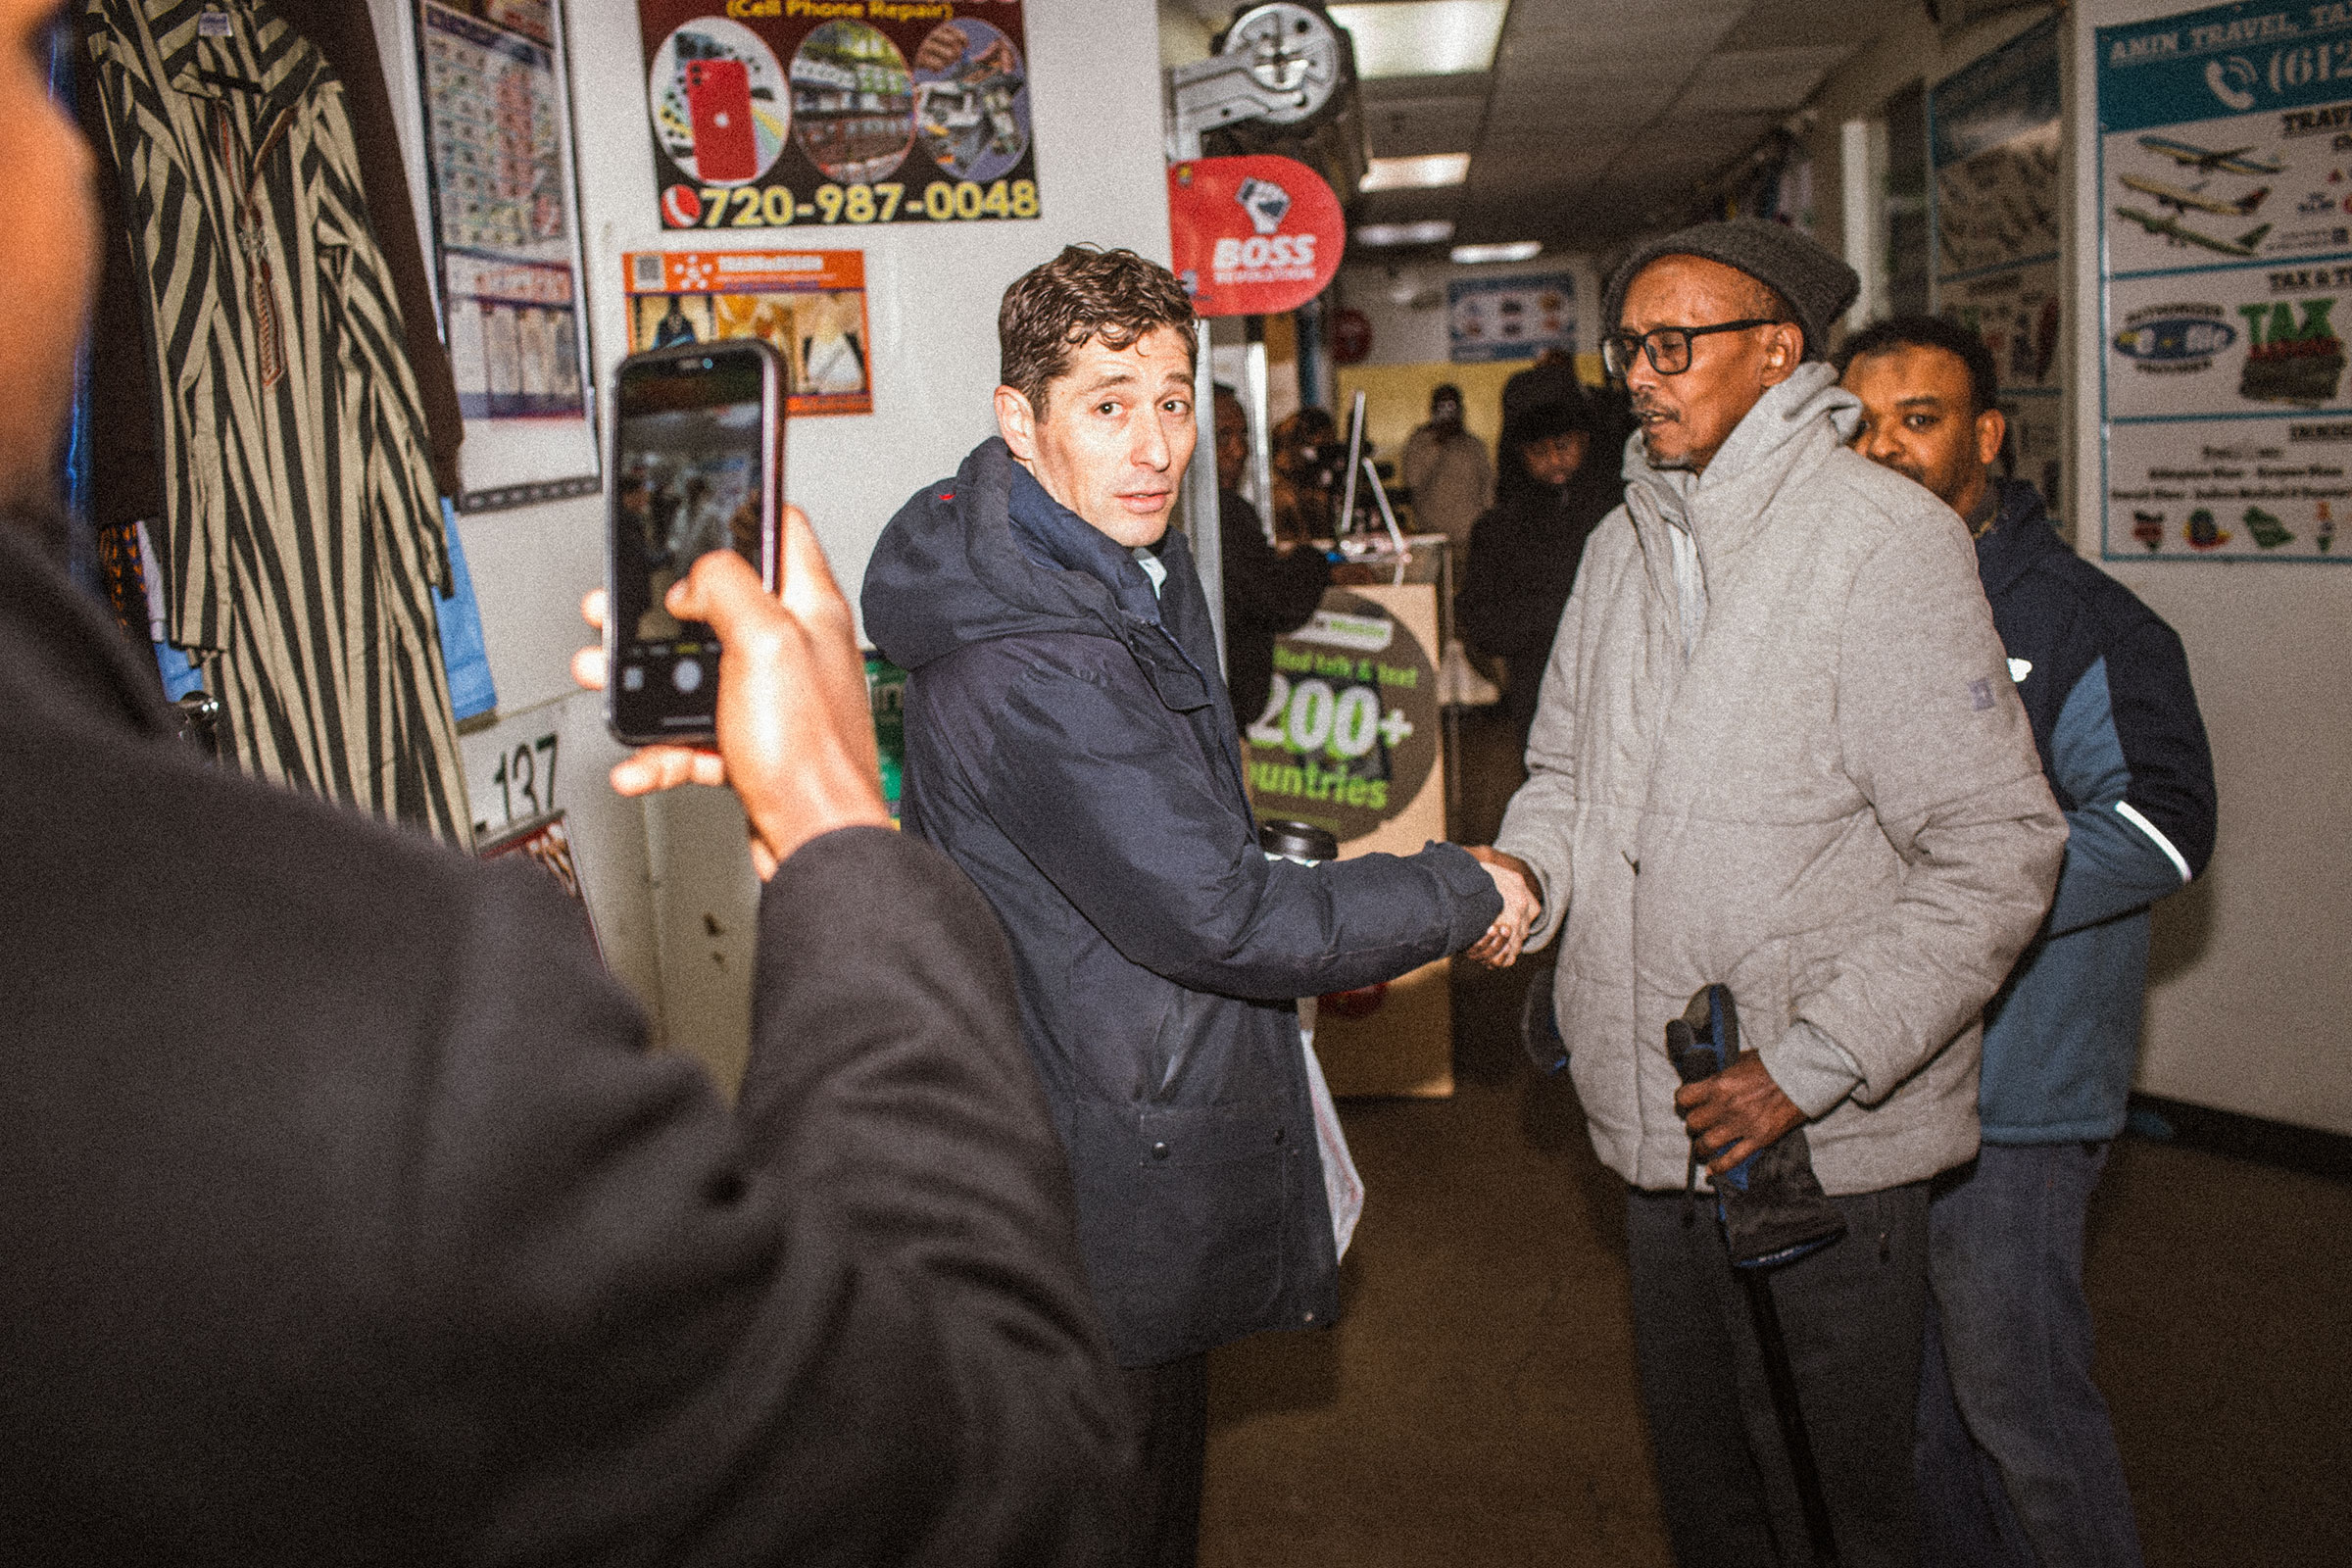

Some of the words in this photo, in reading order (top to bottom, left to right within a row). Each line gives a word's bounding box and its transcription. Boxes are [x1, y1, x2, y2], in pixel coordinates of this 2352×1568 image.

[785, 0, 864, 18] Phone
[701, 180, 1040, 226] 720-987-0048
[1213, 233, 1316, 269] BOSS
[1246, 673, 1414, 758] 200+
